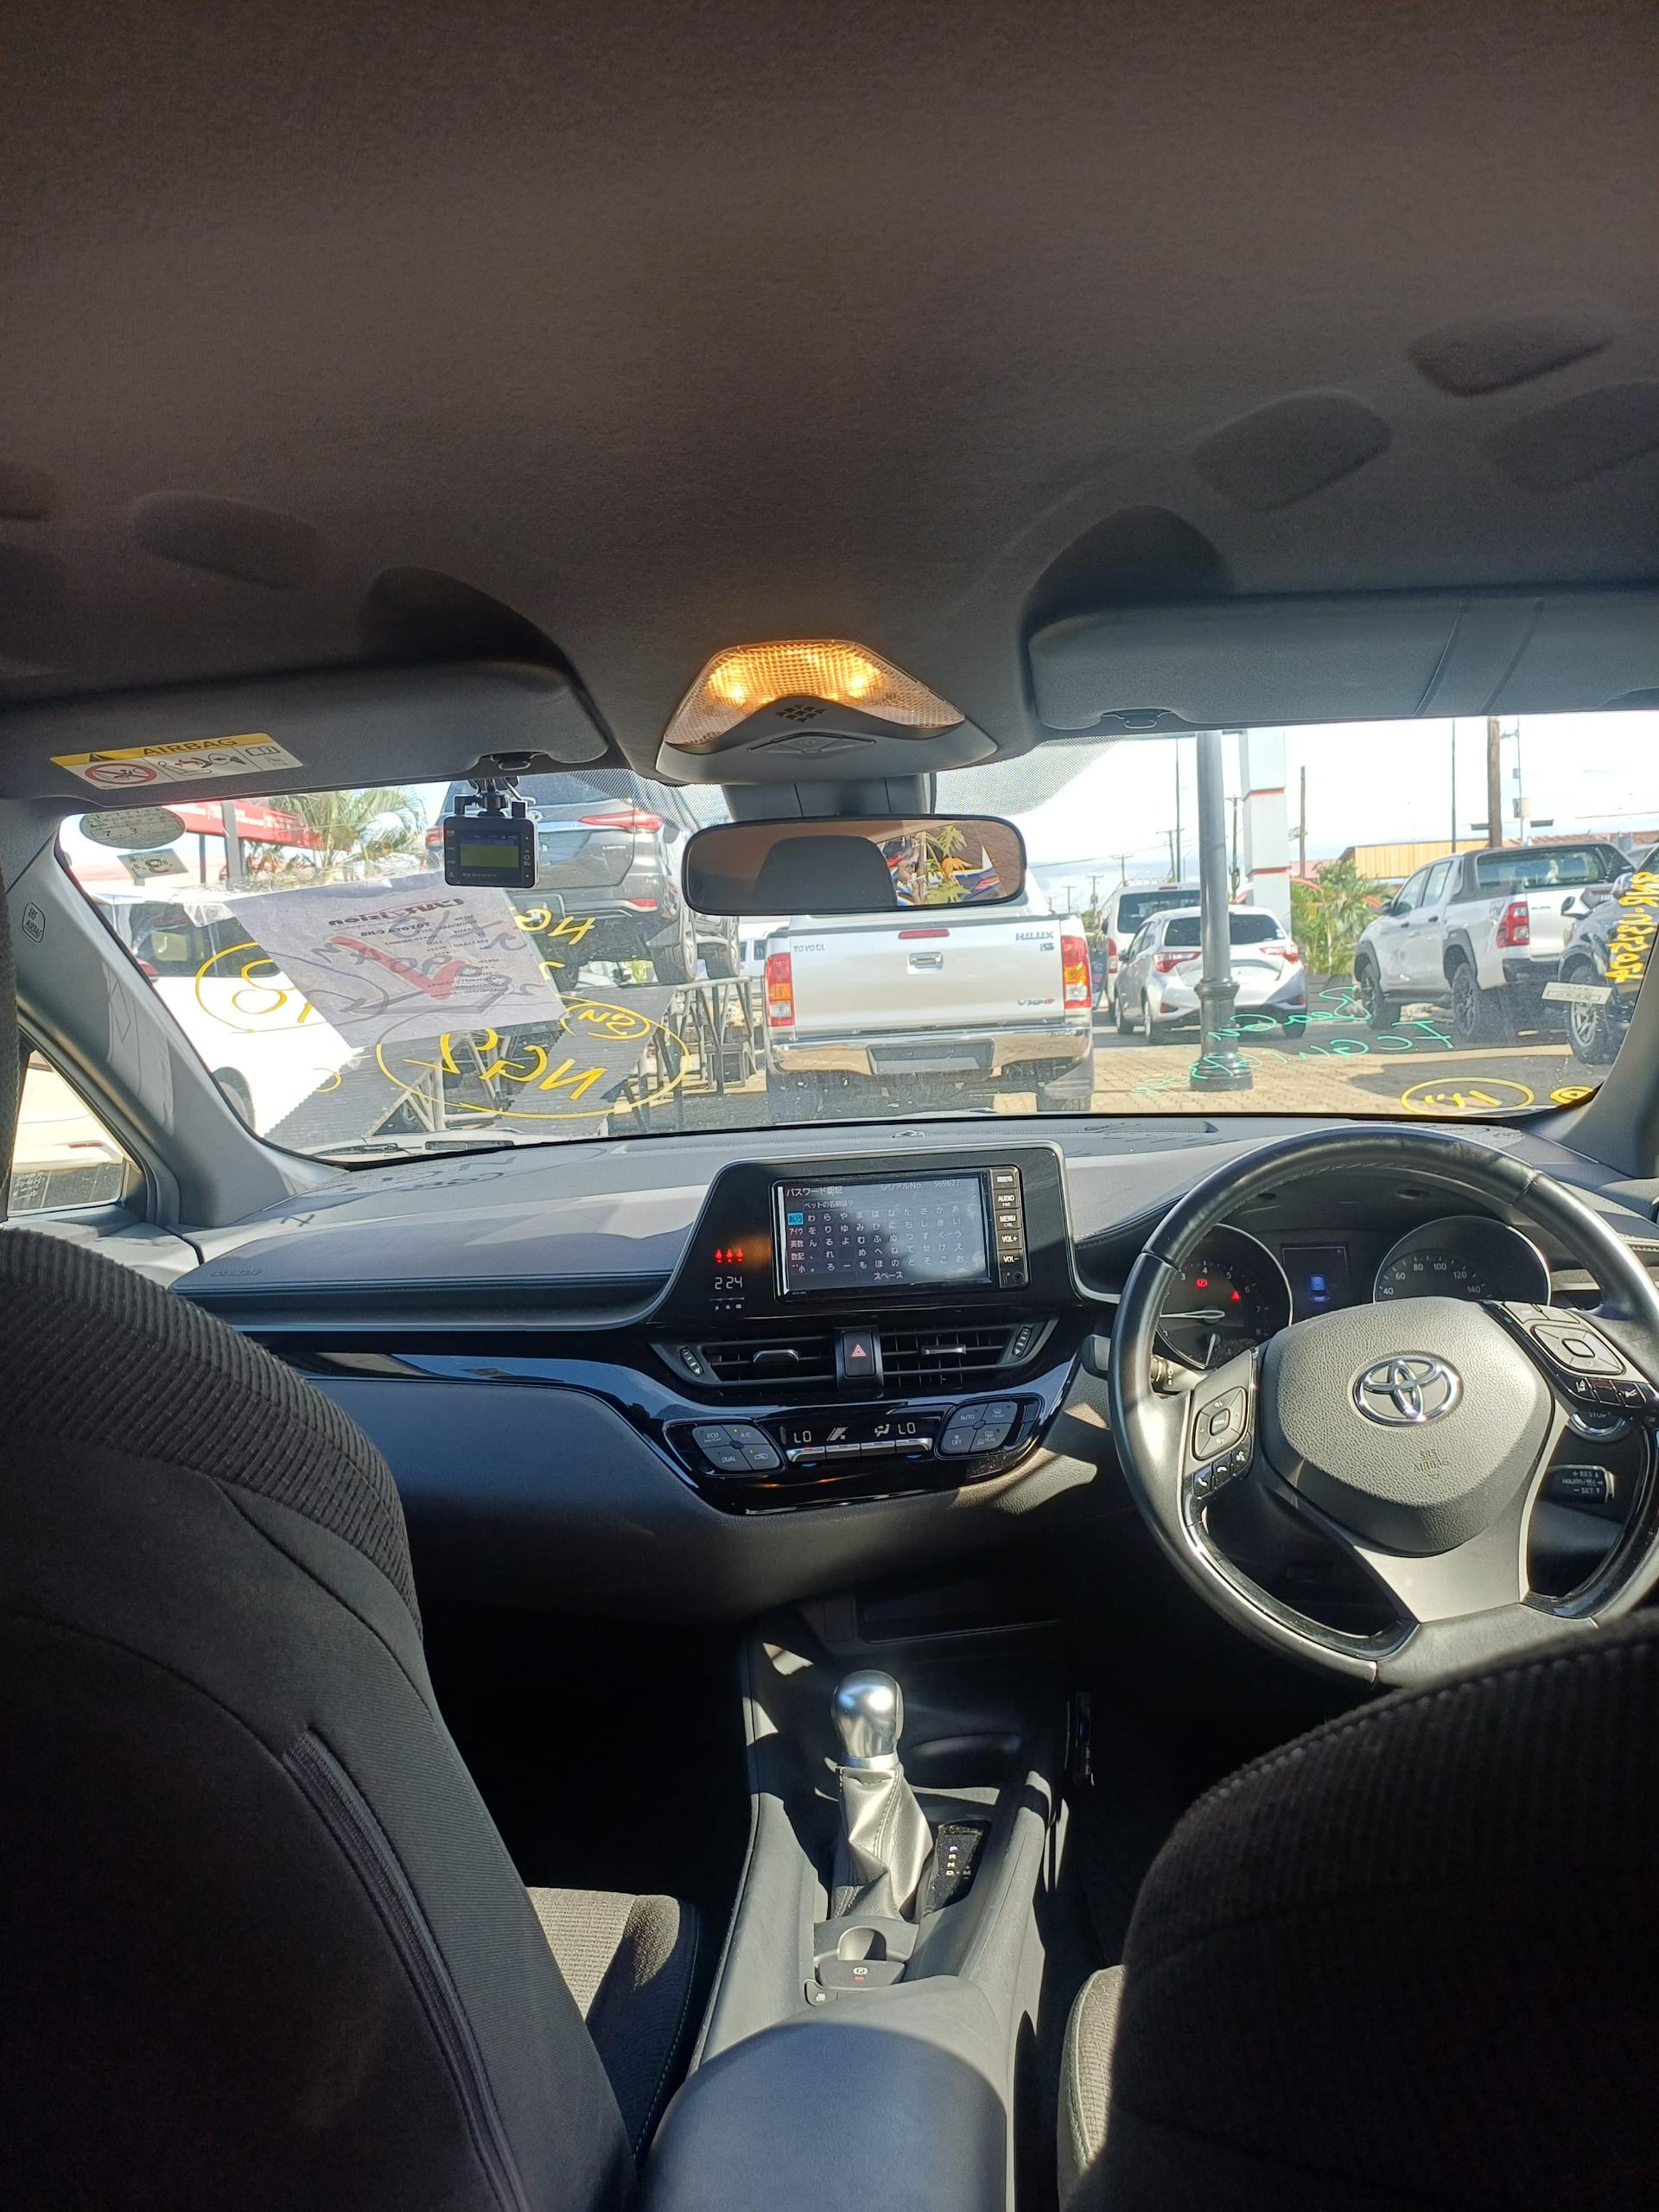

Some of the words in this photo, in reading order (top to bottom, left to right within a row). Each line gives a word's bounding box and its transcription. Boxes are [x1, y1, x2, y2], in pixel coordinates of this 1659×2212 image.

[143, 738, 238, 756] AIRBAG
[1016, 931, 1054, 942] HILUX
[794, 943, 827, 952] TOYOTA
[786, 1185, 844, 1198] パスワード認証
[1000, 1214, 1016, 1223] MENU
[1413, 1262, 1424, 1271] 80
[1433, 1262, 1447, 1271] 100
[874, 1271, 904, 1280] スペース
[1382, 1287, 1394, 1295] 40
[793, 1430, 812, 1444] LO
[898, 1421, 917, 1434] LO
